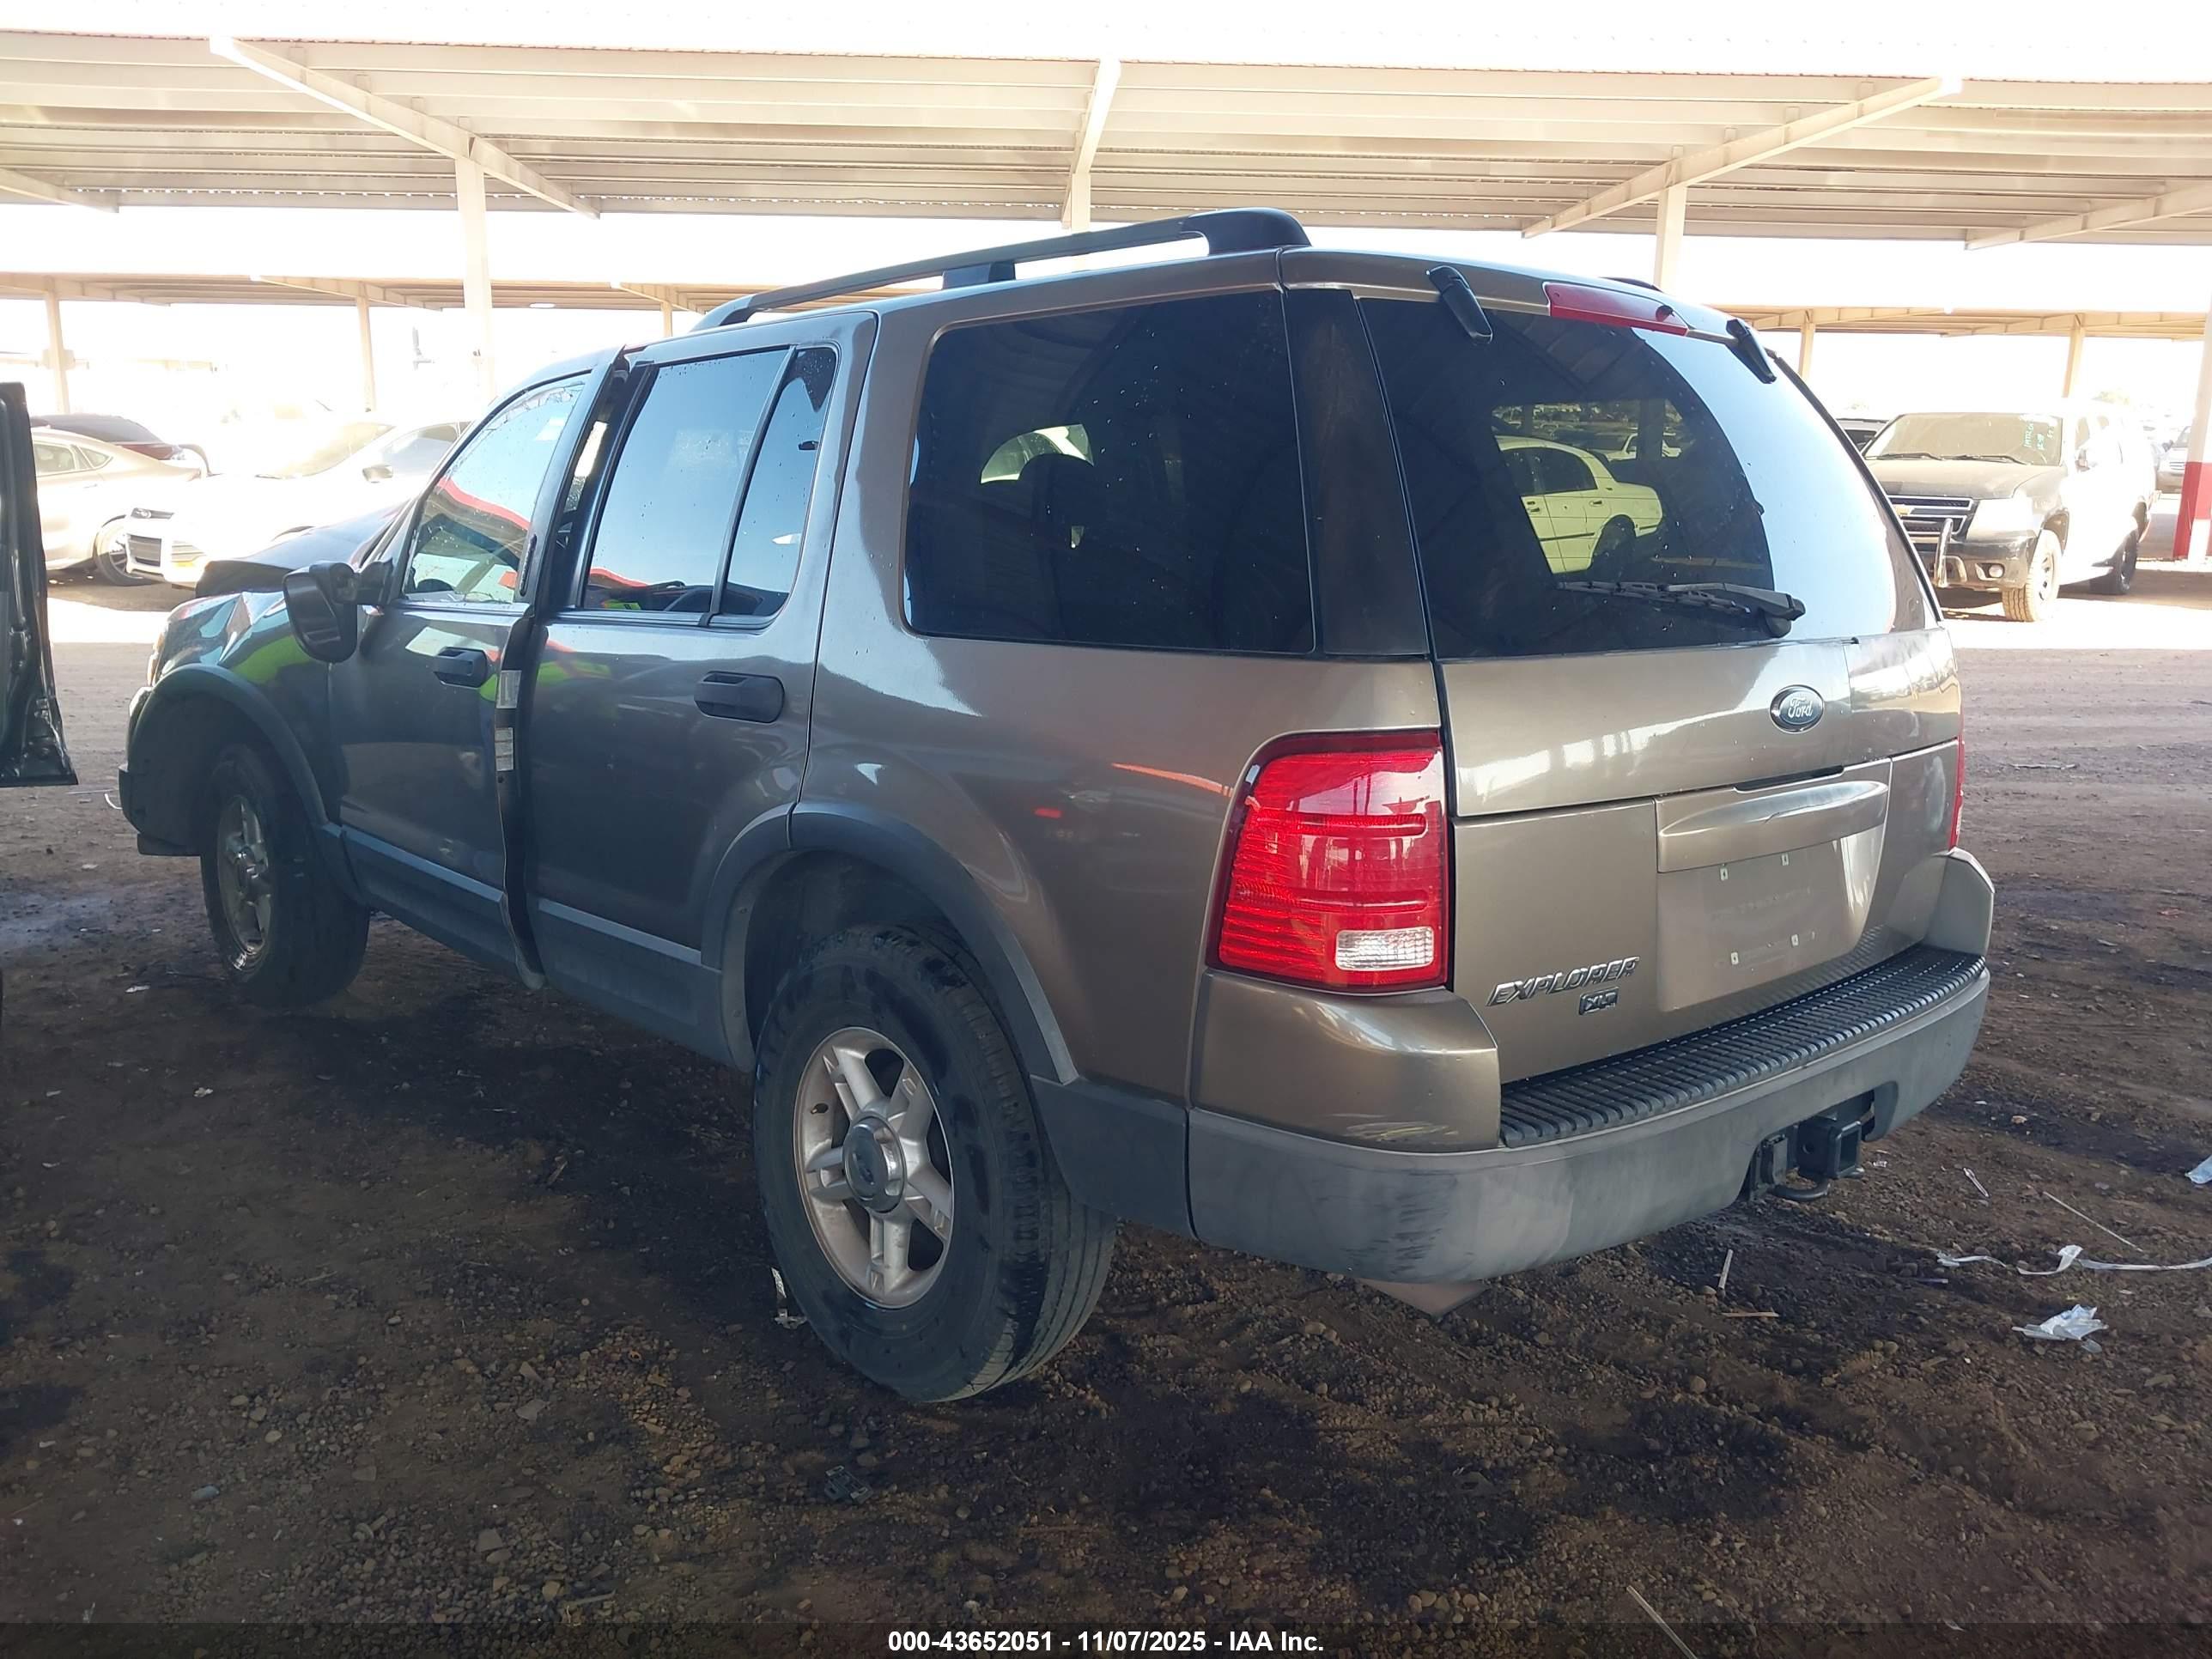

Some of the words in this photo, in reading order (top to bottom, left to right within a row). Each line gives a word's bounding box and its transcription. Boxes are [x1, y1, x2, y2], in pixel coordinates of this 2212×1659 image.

[1787, 696, 1814, 719] Ford
[1485, 957, 1640, 1006] EXPLORER
[1582, 990, 1618, 1012] XLT
